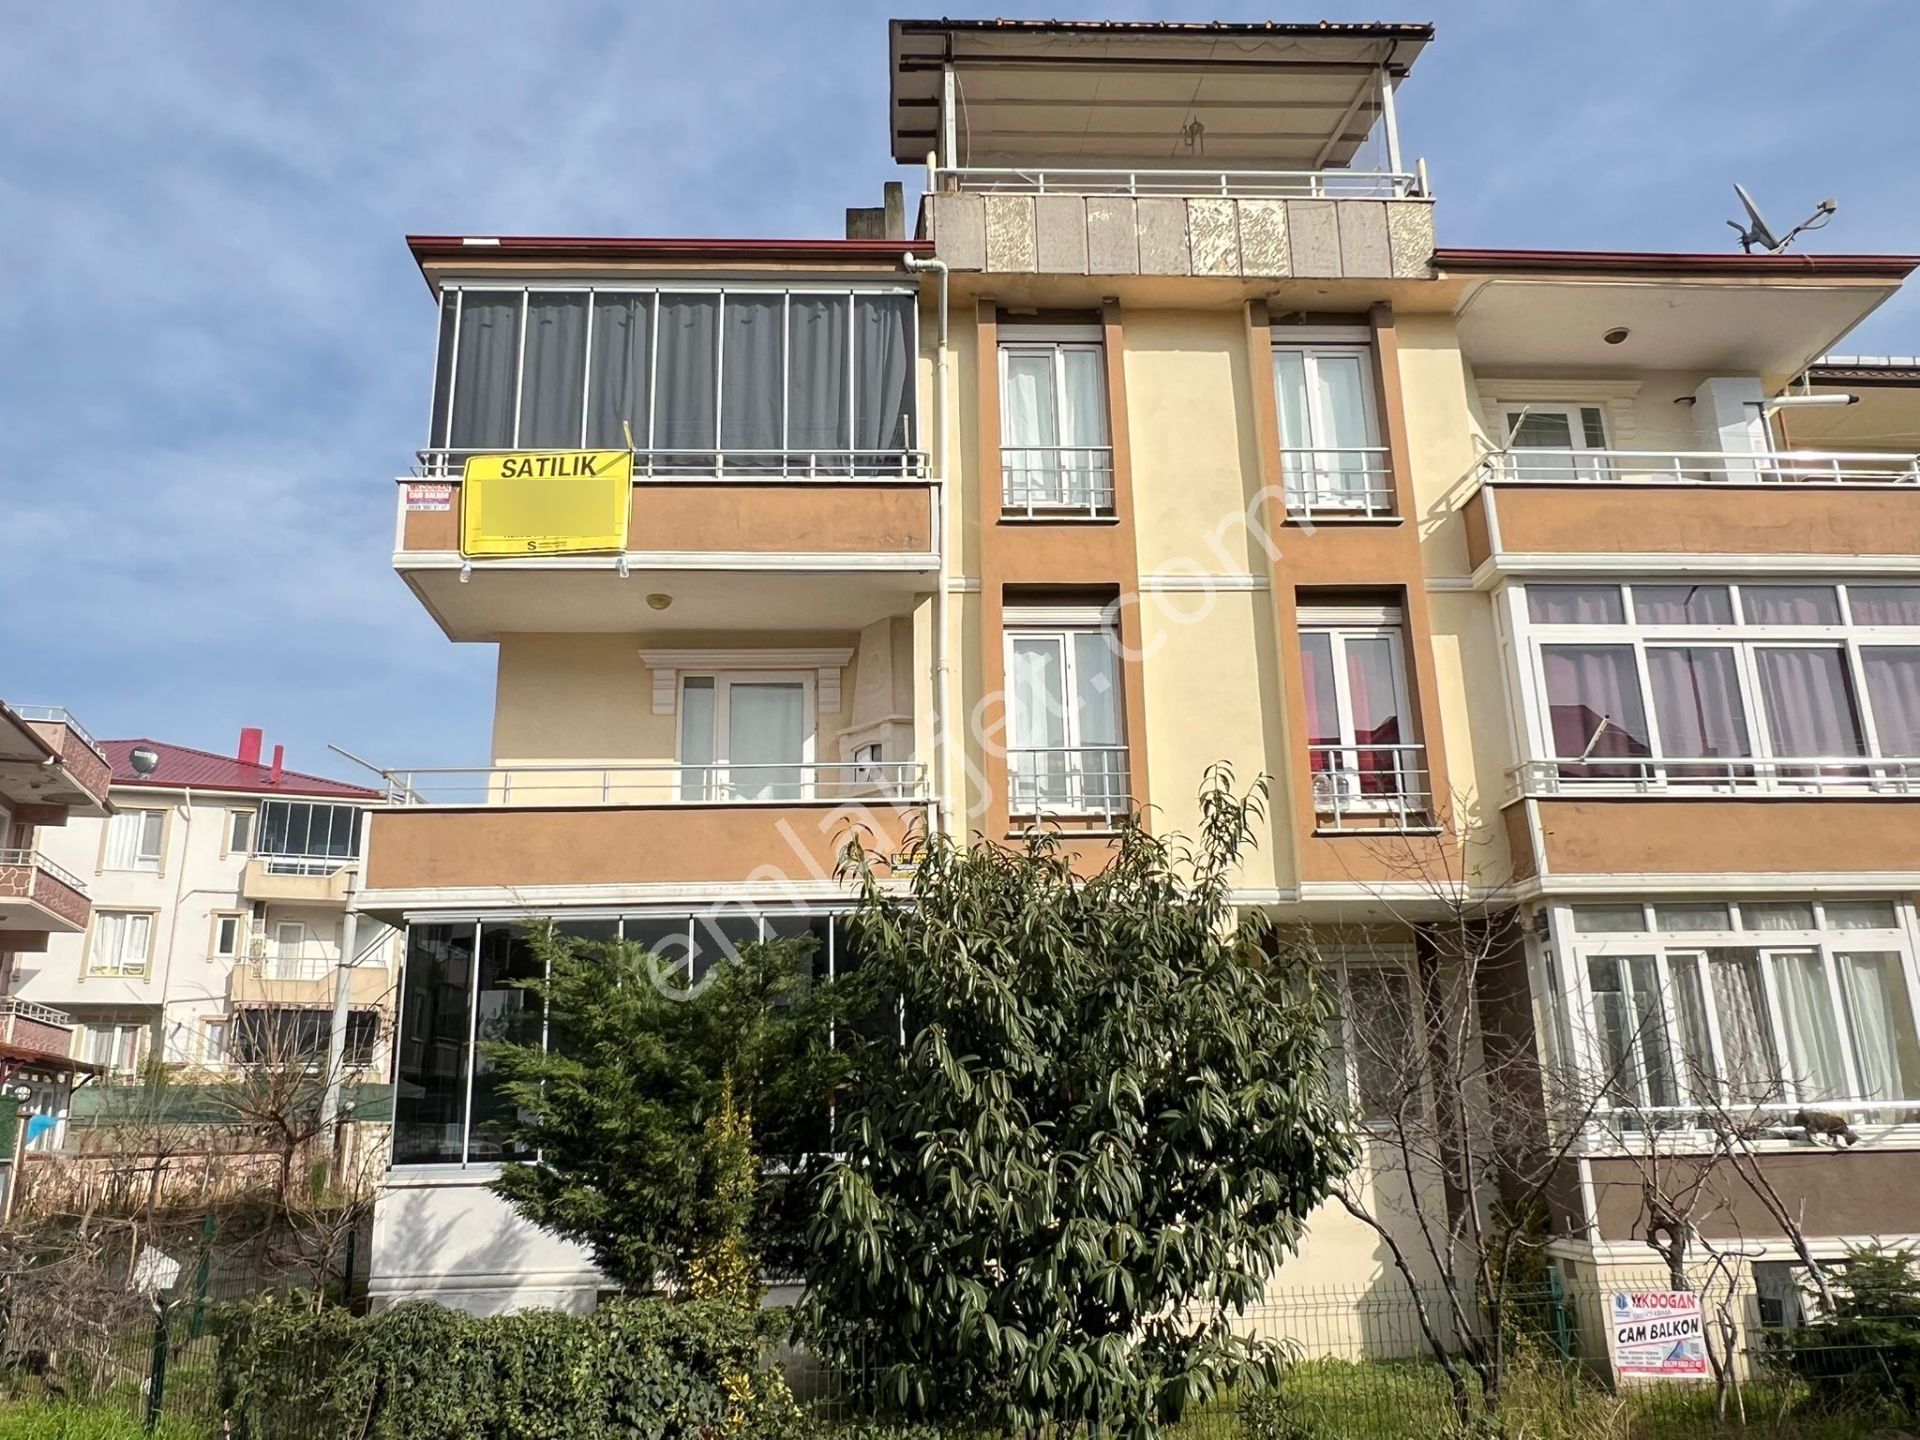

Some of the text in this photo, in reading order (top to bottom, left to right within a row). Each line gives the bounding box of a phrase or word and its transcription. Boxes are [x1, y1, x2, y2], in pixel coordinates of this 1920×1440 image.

[501, 455, 597, 478] SATILIK
[1618, 1317, 1699, 1344] CAM BALKON
